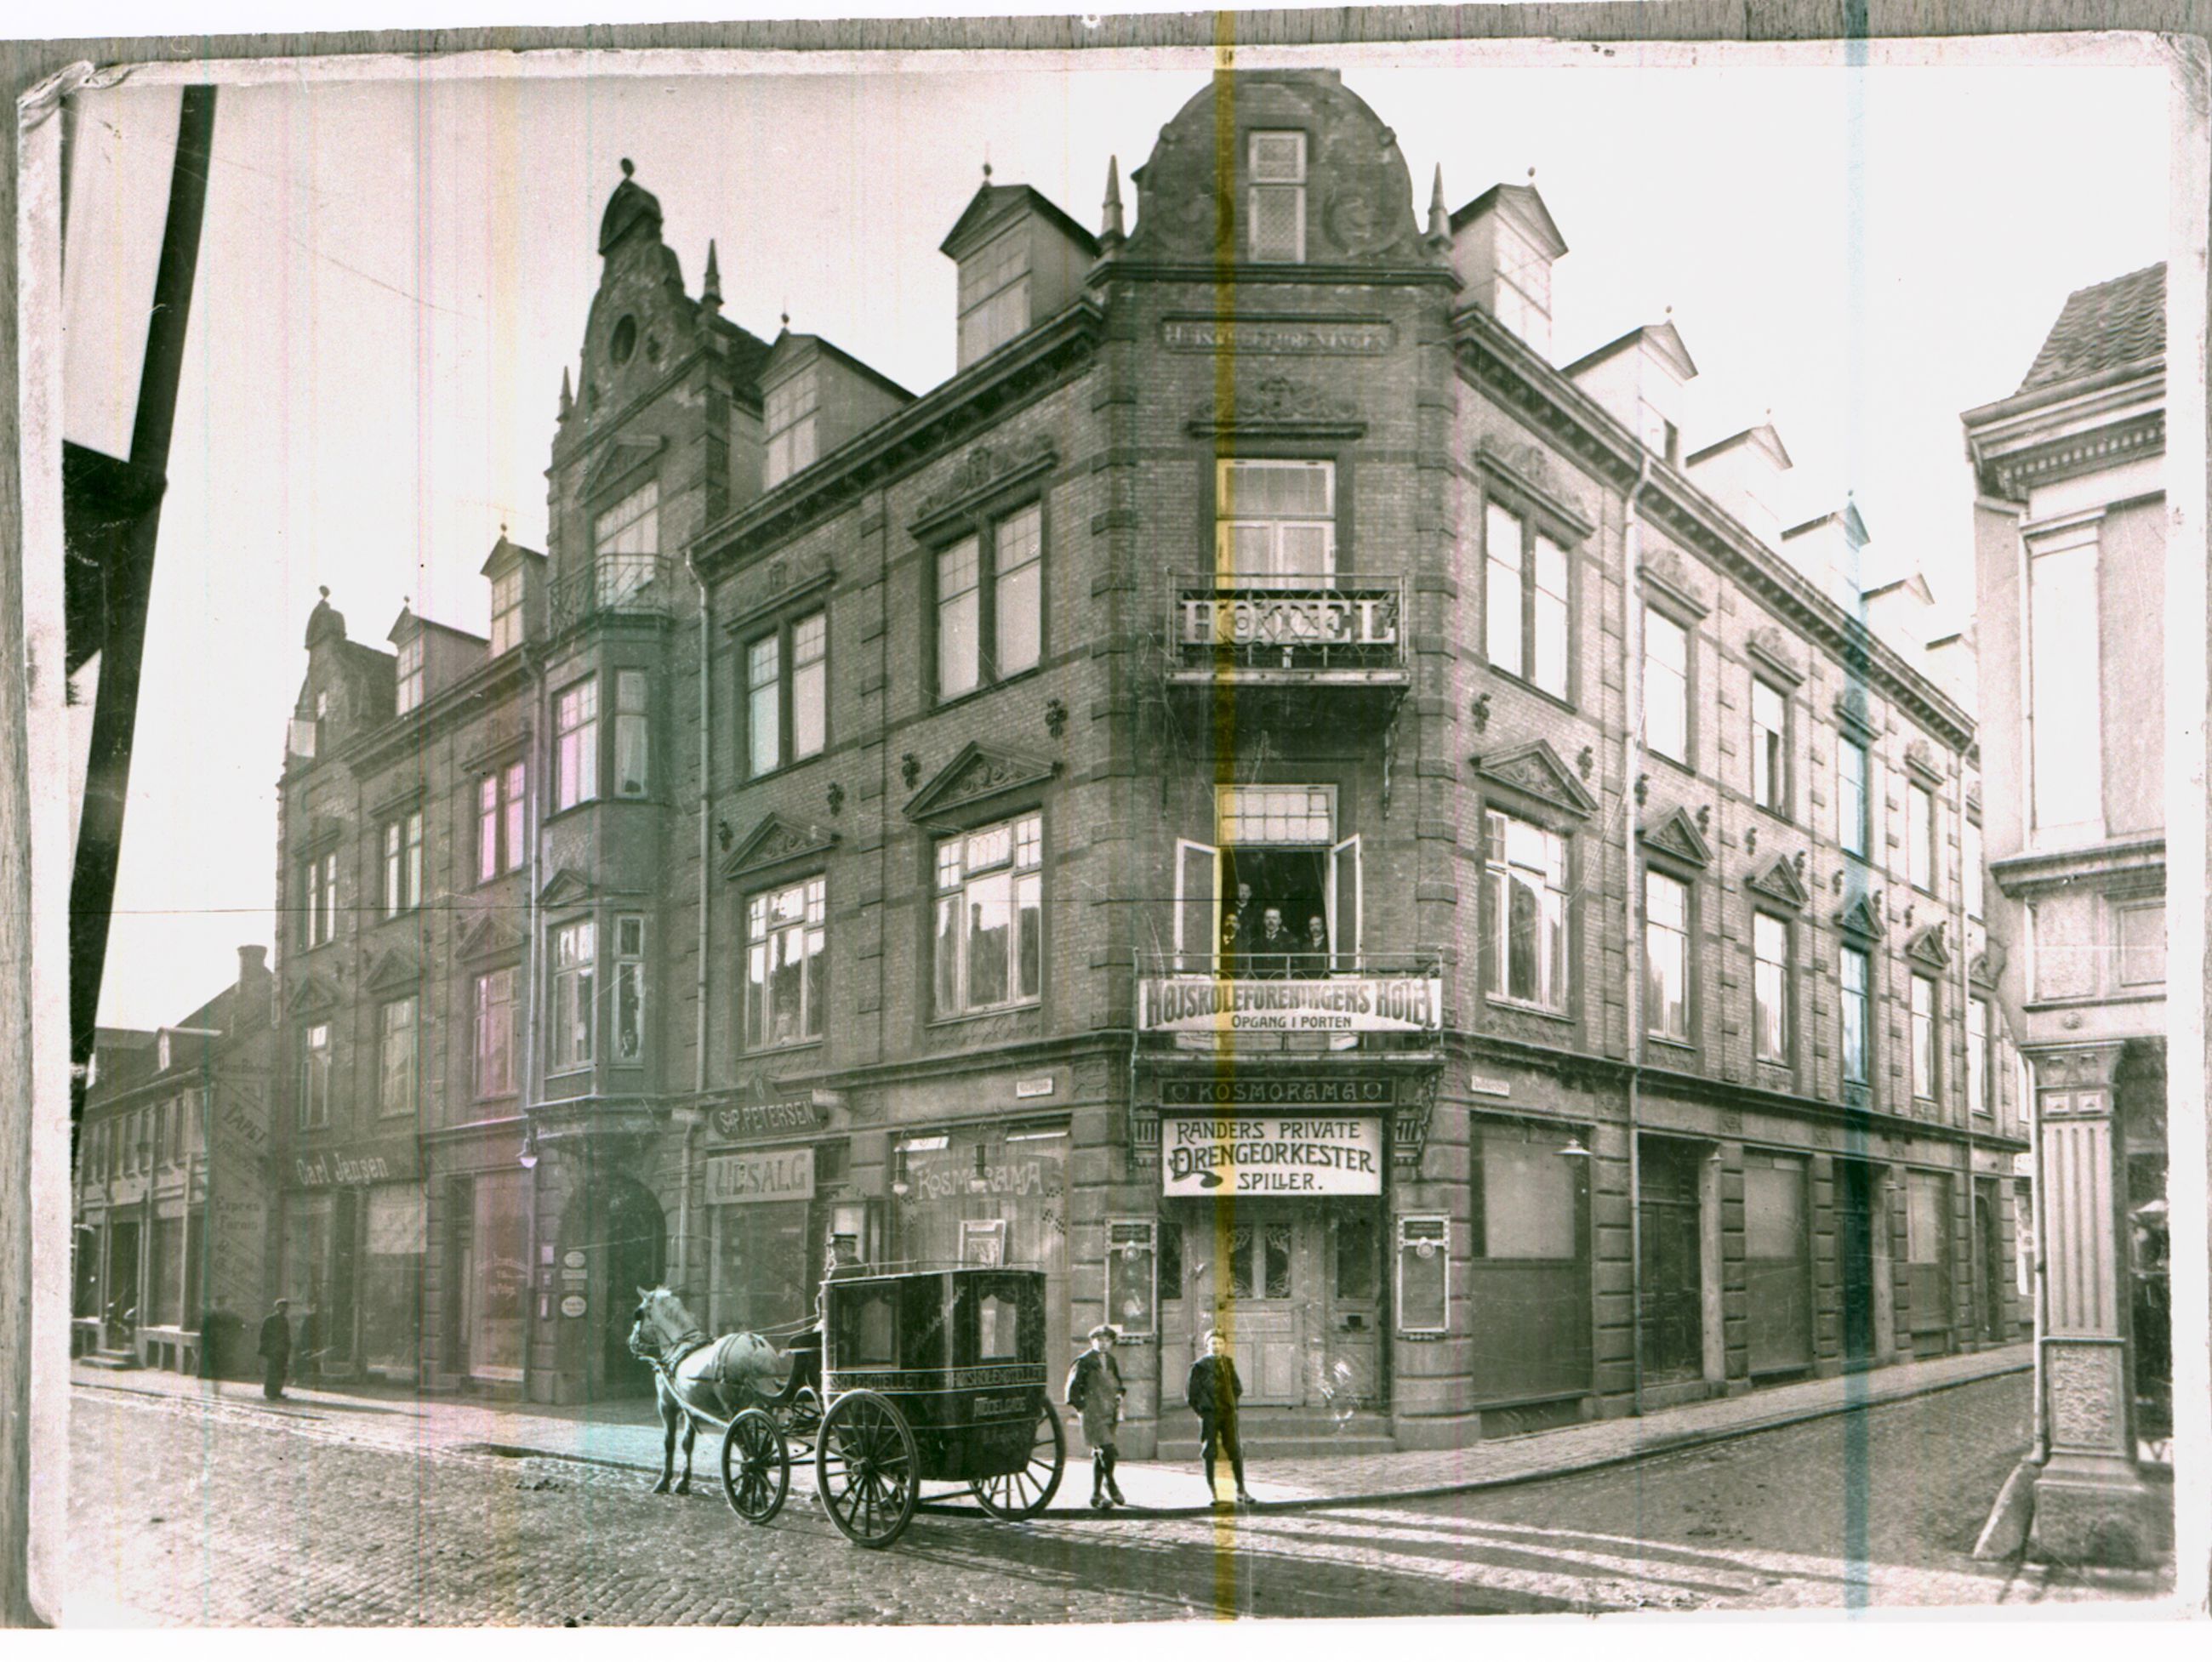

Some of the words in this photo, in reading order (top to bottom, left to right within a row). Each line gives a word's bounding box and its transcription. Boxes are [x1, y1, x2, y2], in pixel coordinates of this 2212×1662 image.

[1180, 600, 1397, 644] HOTEL
[1146, 983, 1371, 1028] HØJSKOLEFORENINGENS
[1375, 980, 1436, 1029] HOTEL
[1231, 1015, 1286, 1028] OPGANG
[1291, 1016, 1297, 1027] I
[1301, 1016, 1352, 1028] PORTEN
[1197, 1083, 1359, 1101] KOSMORAMA
[1176, 1121, 1265, 1145] RANDERS
[1280, 1121, 1361, 1139] PRIVATE
[295, 1153, 332, 1187] Carl
[334, 1151, 390, 1185] Jensen
[1168, 1142, 1376, 1183] DRENGEORKESTER
[1237, 1173, 1324, 1191] SPILLER.
